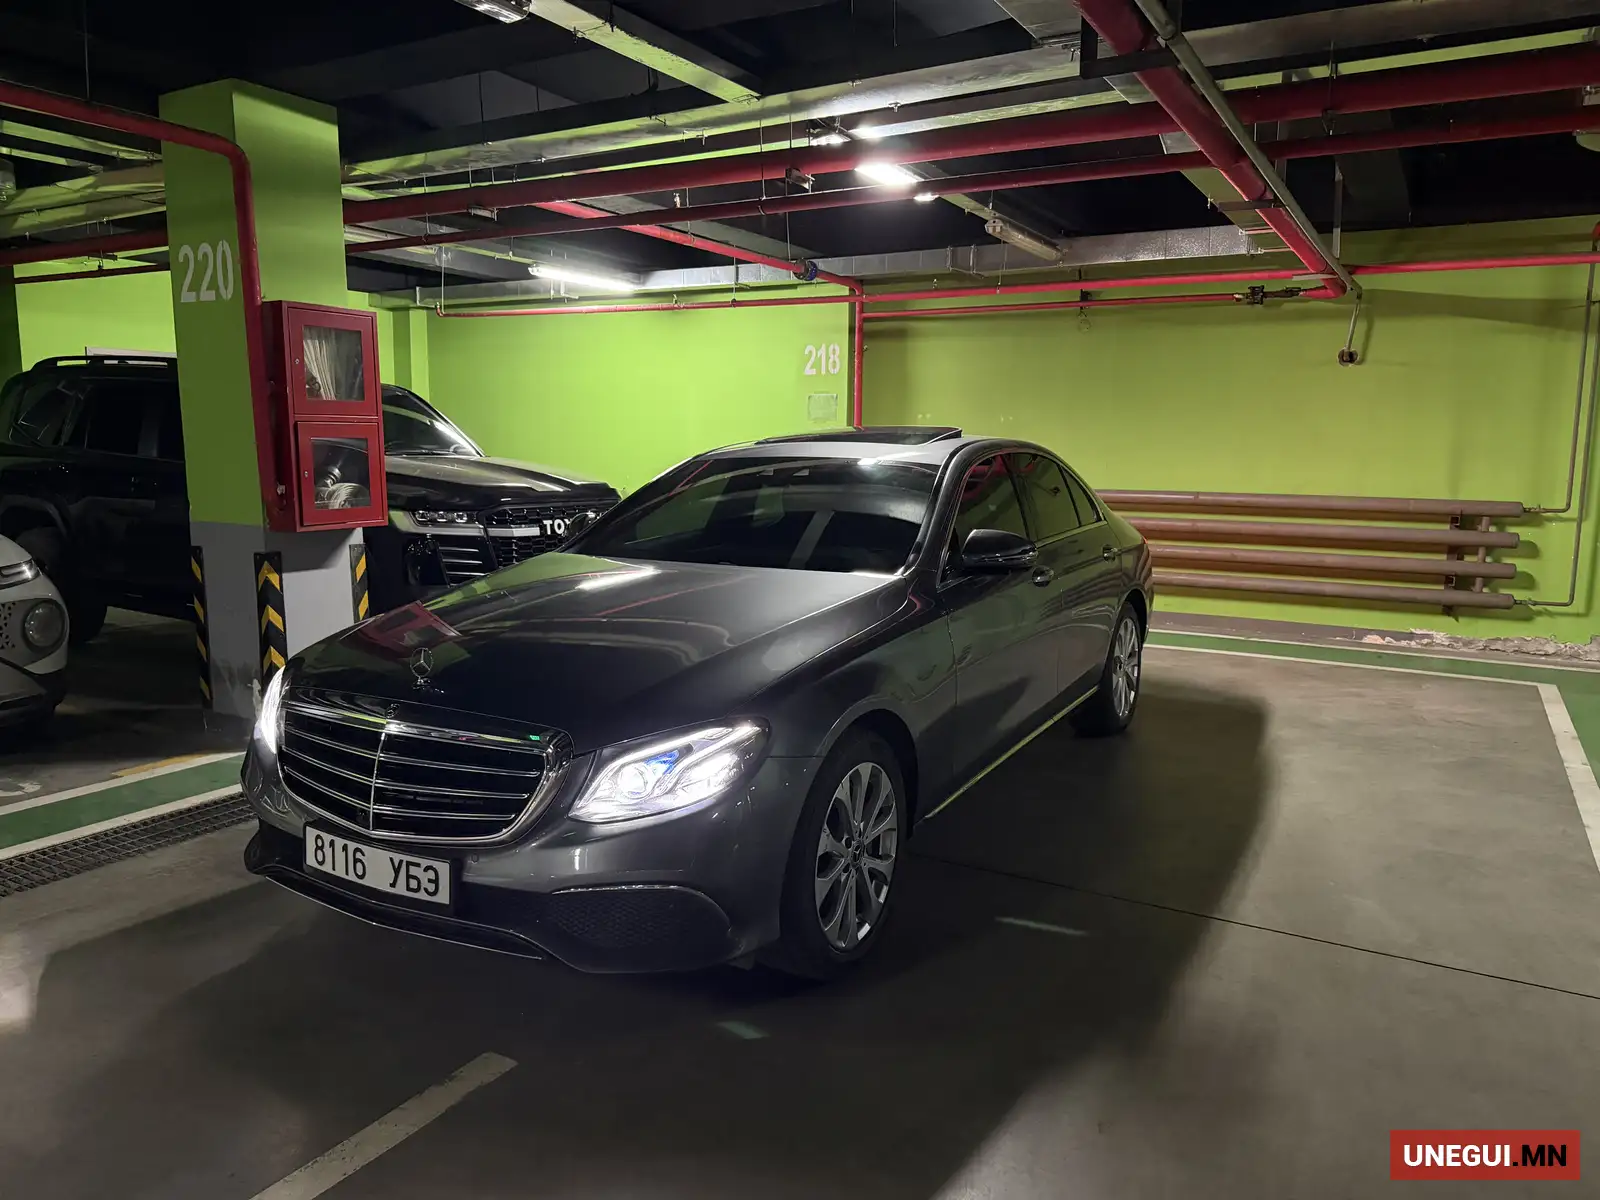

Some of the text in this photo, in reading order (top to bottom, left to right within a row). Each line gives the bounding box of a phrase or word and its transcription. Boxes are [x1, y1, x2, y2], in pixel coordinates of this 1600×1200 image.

[178, 239, 234, 303] 220
[803, 343, 841, 376] 218
[314, 833, 440, 897] 8116 УБЭ
